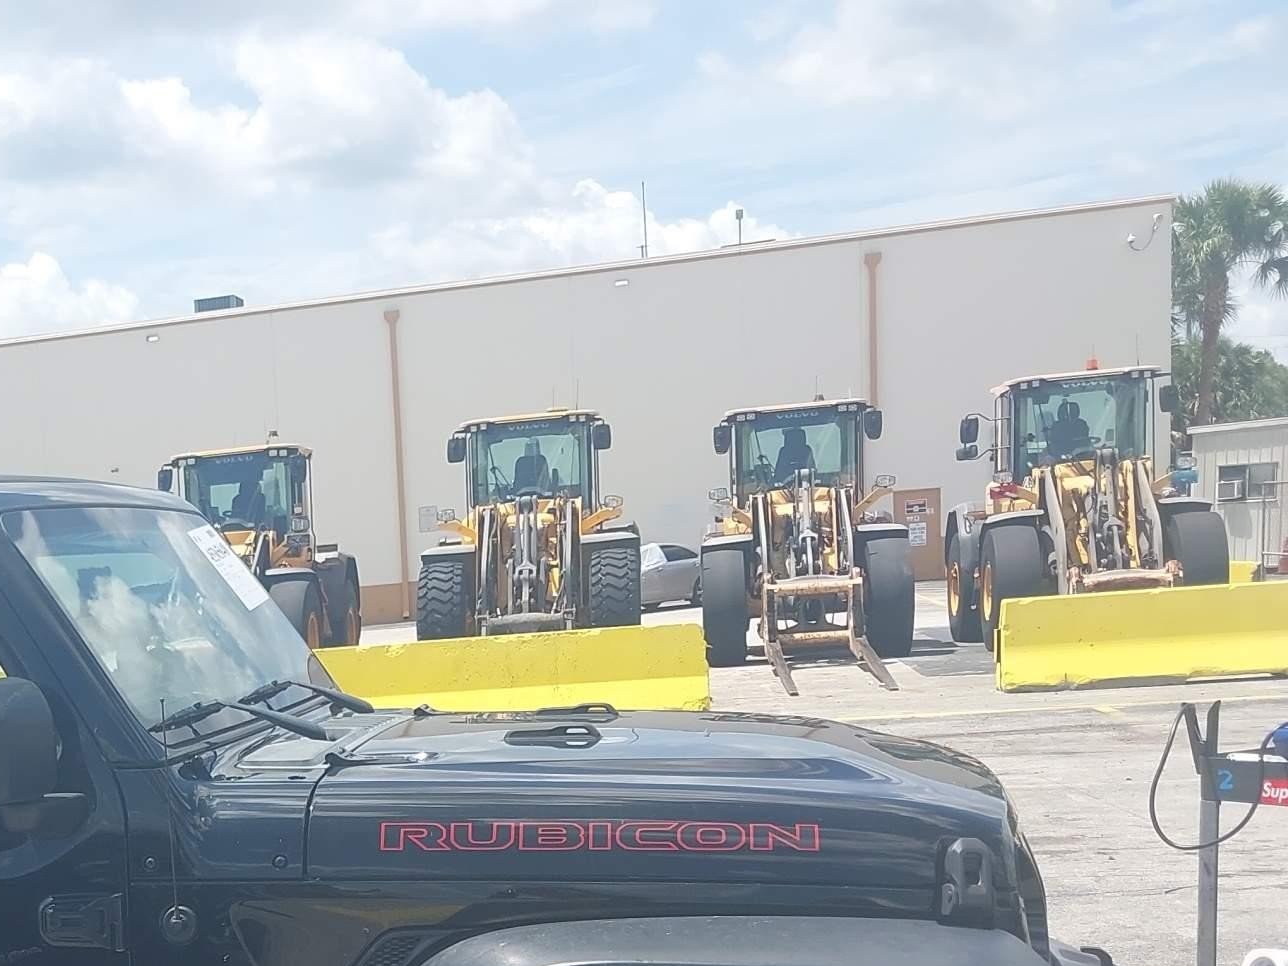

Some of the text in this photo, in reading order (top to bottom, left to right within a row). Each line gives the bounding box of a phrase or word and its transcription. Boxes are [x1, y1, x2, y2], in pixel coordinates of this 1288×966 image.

[1217, 768, 1234, 791] 2
[1261, 780, 1288, 804] Sup
[379, 820, 821, 852] RUBICON
